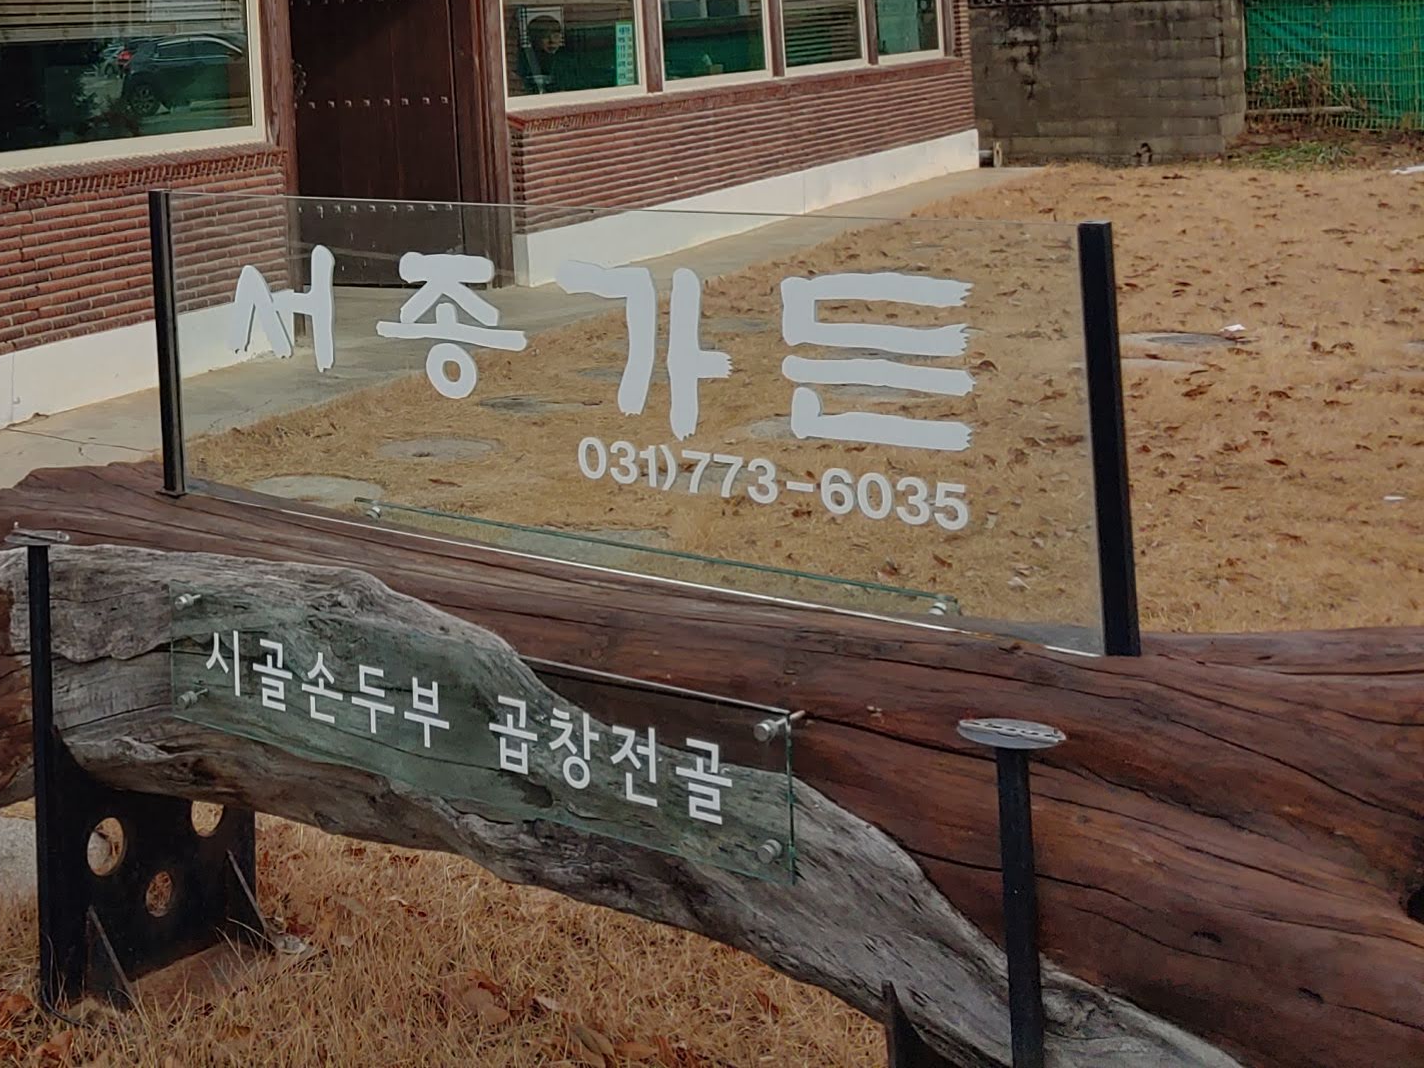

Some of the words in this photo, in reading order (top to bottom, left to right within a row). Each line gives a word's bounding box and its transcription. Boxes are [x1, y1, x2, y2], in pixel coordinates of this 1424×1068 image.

[232, 244, 976, 451] 서종가든
[577, 436, 970, 530] 031)773-6035
[205, 630, 451, 749] 시골손두부
[488, 694, 733, 825] 곱창전골
